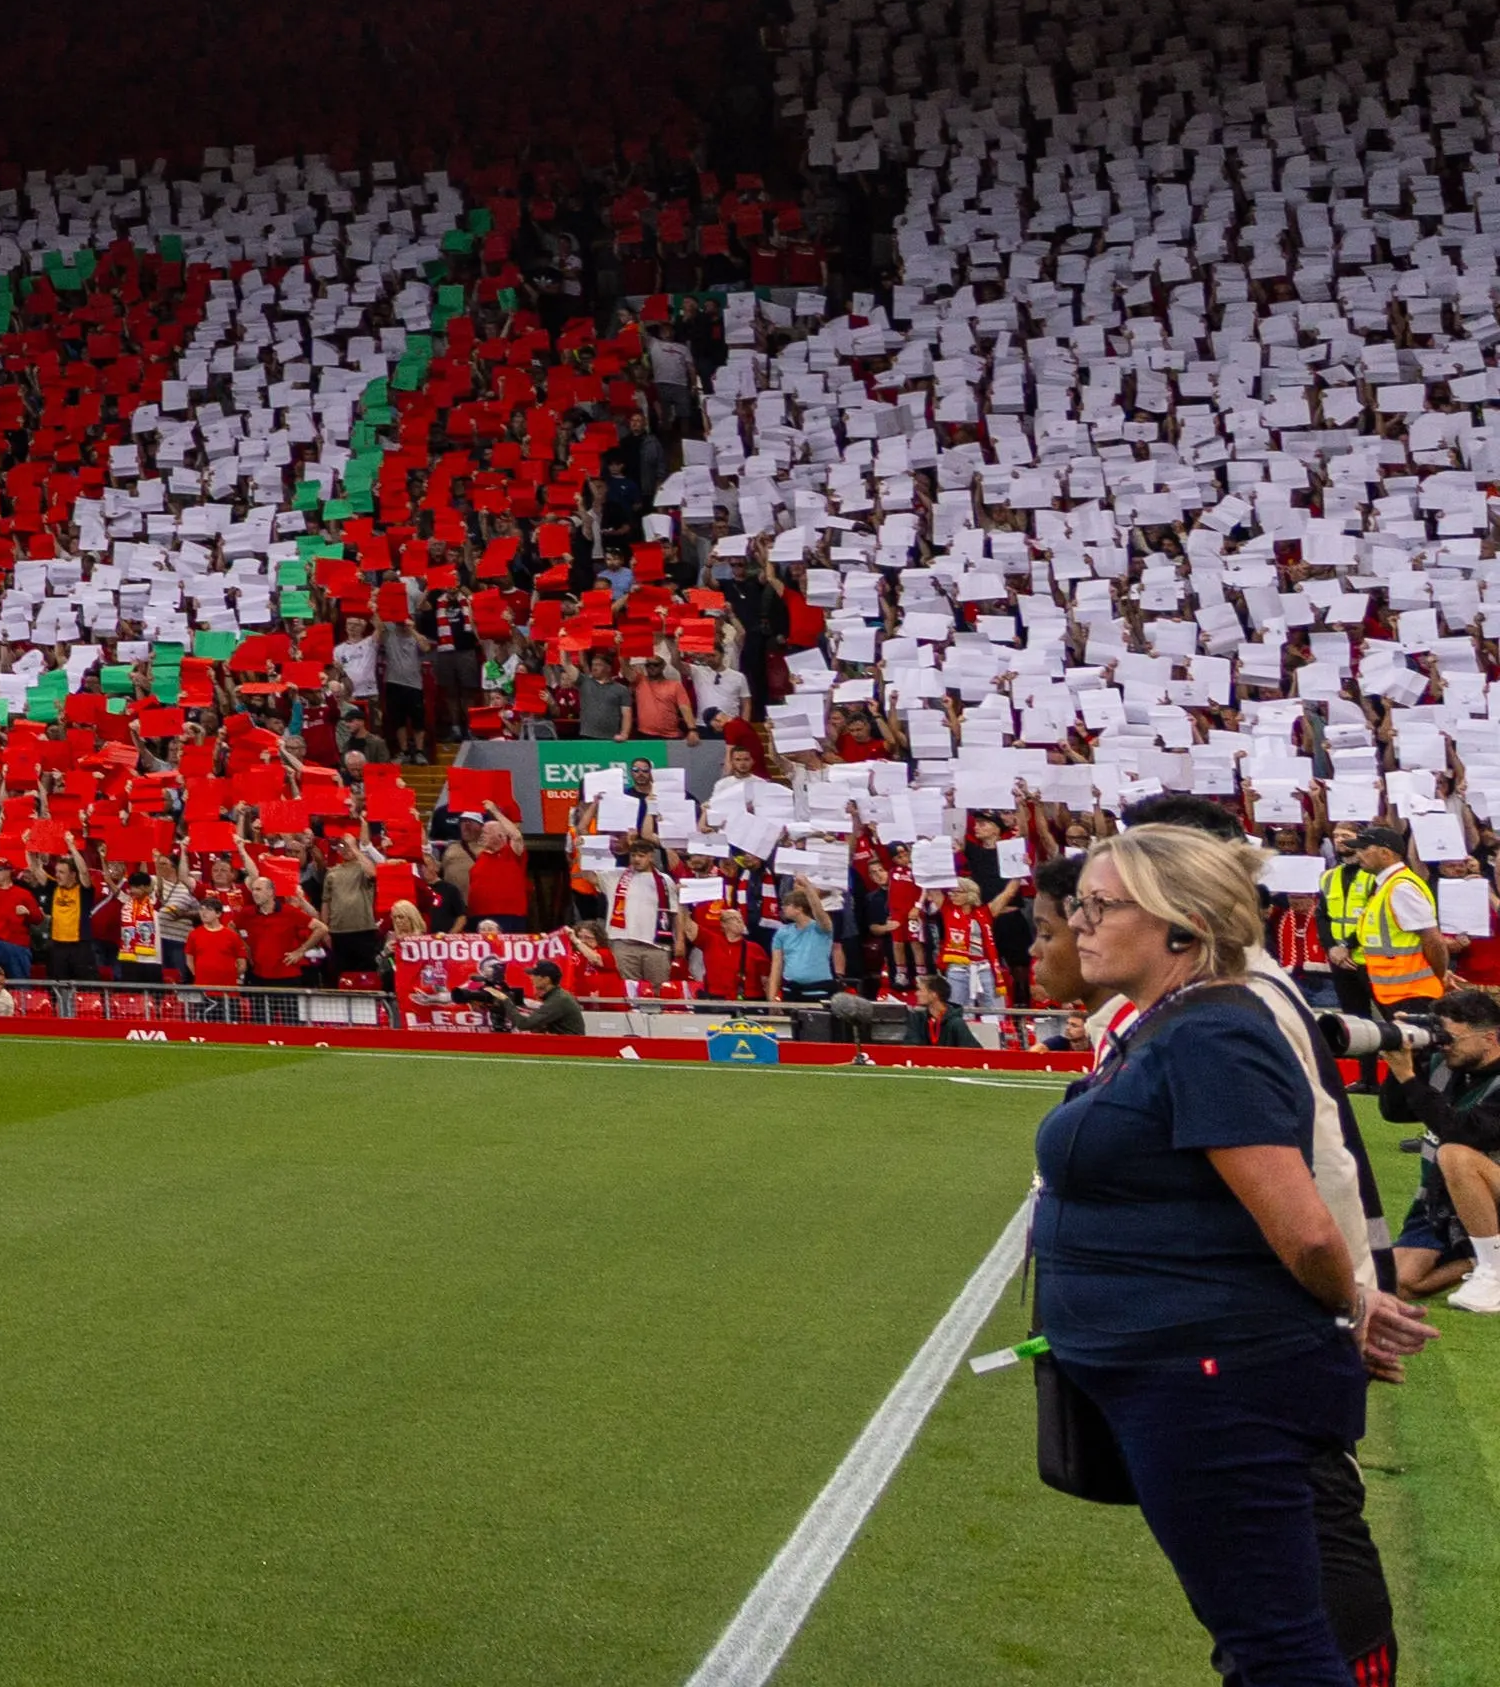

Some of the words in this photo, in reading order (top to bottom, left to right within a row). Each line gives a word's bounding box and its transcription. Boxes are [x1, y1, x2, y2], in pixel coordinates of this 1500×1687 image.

[544, 764, 601, 782] EXIT
[546, 790, 579, 799] BLOC
[400, 940, 491, 962] DIOGO
[499, 935, 567, 962] JOTA
[405, 1010, 492, 1027] LEG
